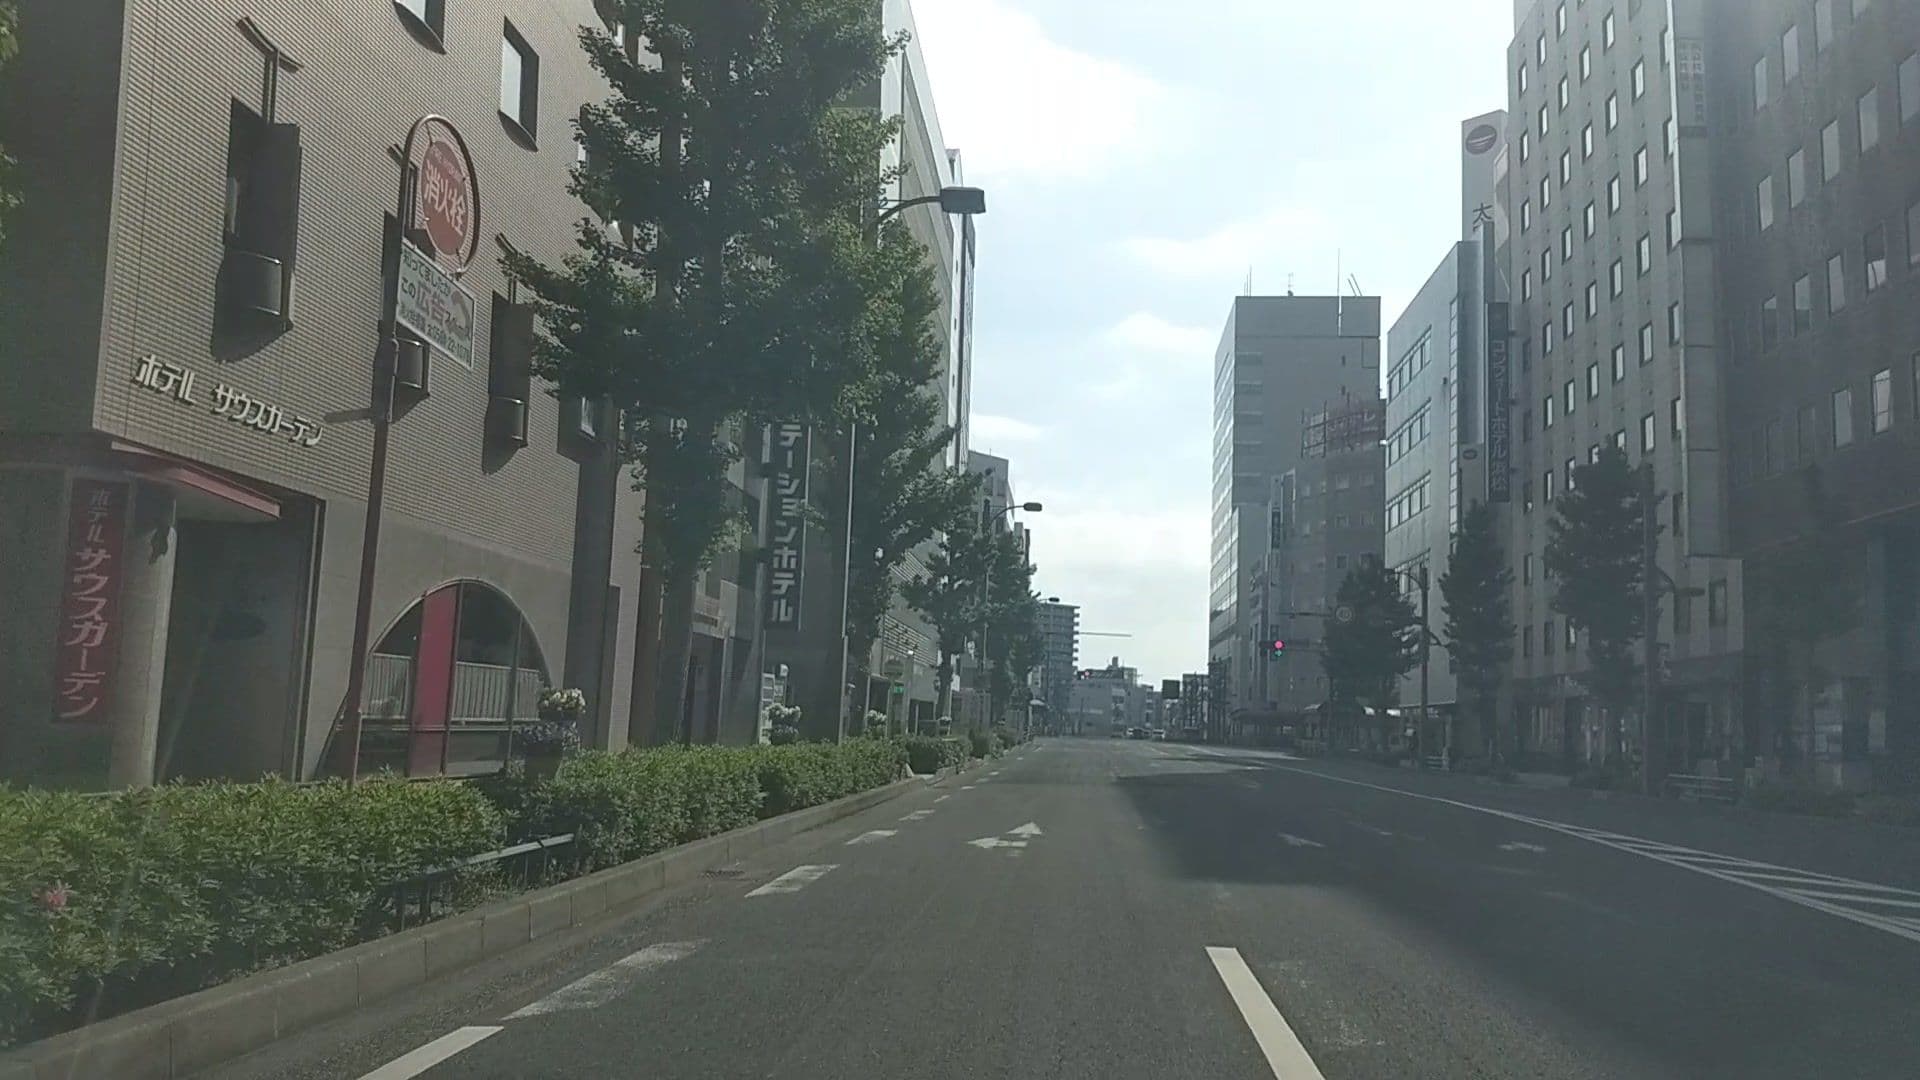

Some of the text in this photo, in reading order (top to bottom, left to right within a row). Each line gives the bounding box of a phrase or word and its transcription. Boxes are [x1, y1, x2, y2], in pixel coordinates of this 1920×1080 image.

[424, 159, 465, 236] 消火栓
[1473, 202, 1493, 232] 太
[136, 354, 196, 404] ホテル
[771, 415, 802, 622] テーションホテル
